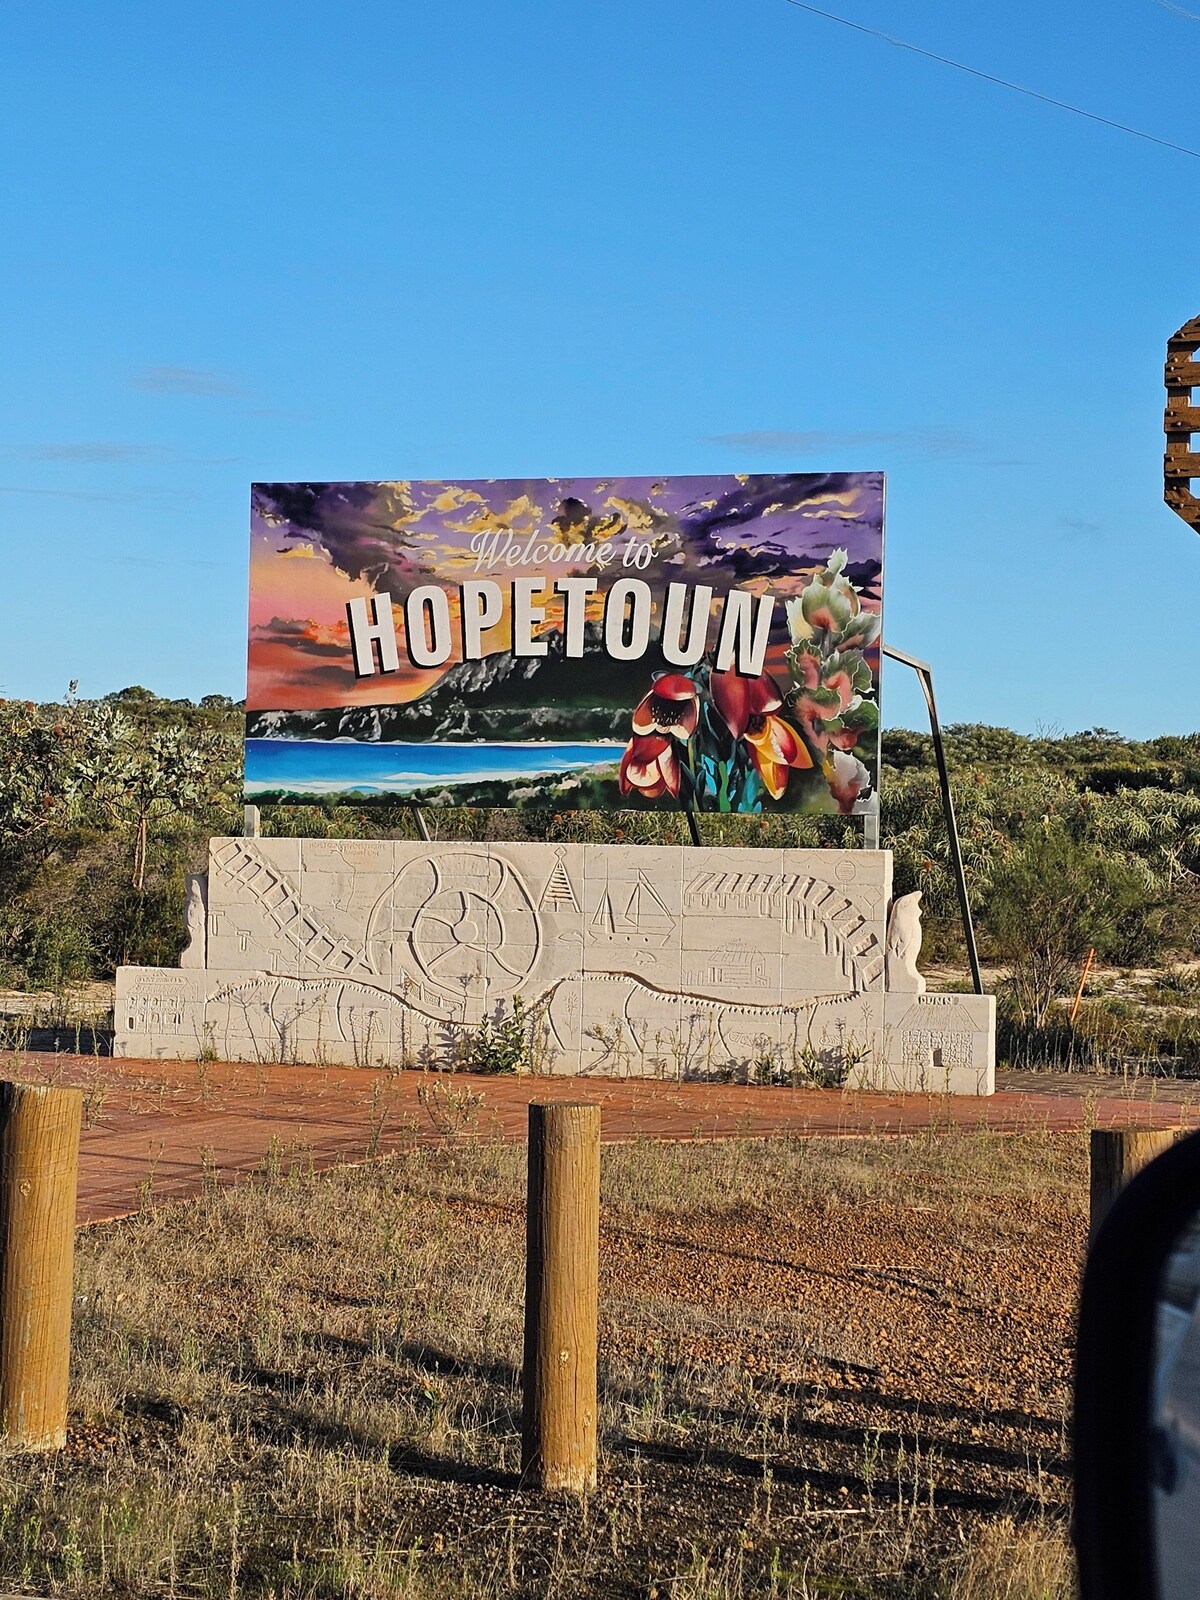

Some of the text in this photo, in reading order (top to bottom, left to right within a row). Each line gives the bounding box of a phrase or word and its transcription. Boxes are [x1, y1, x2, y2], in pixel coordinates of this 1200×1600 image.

[470, 528, 658, 572] Welcome to
[346, 576, 776, 678] HOPETOUN
